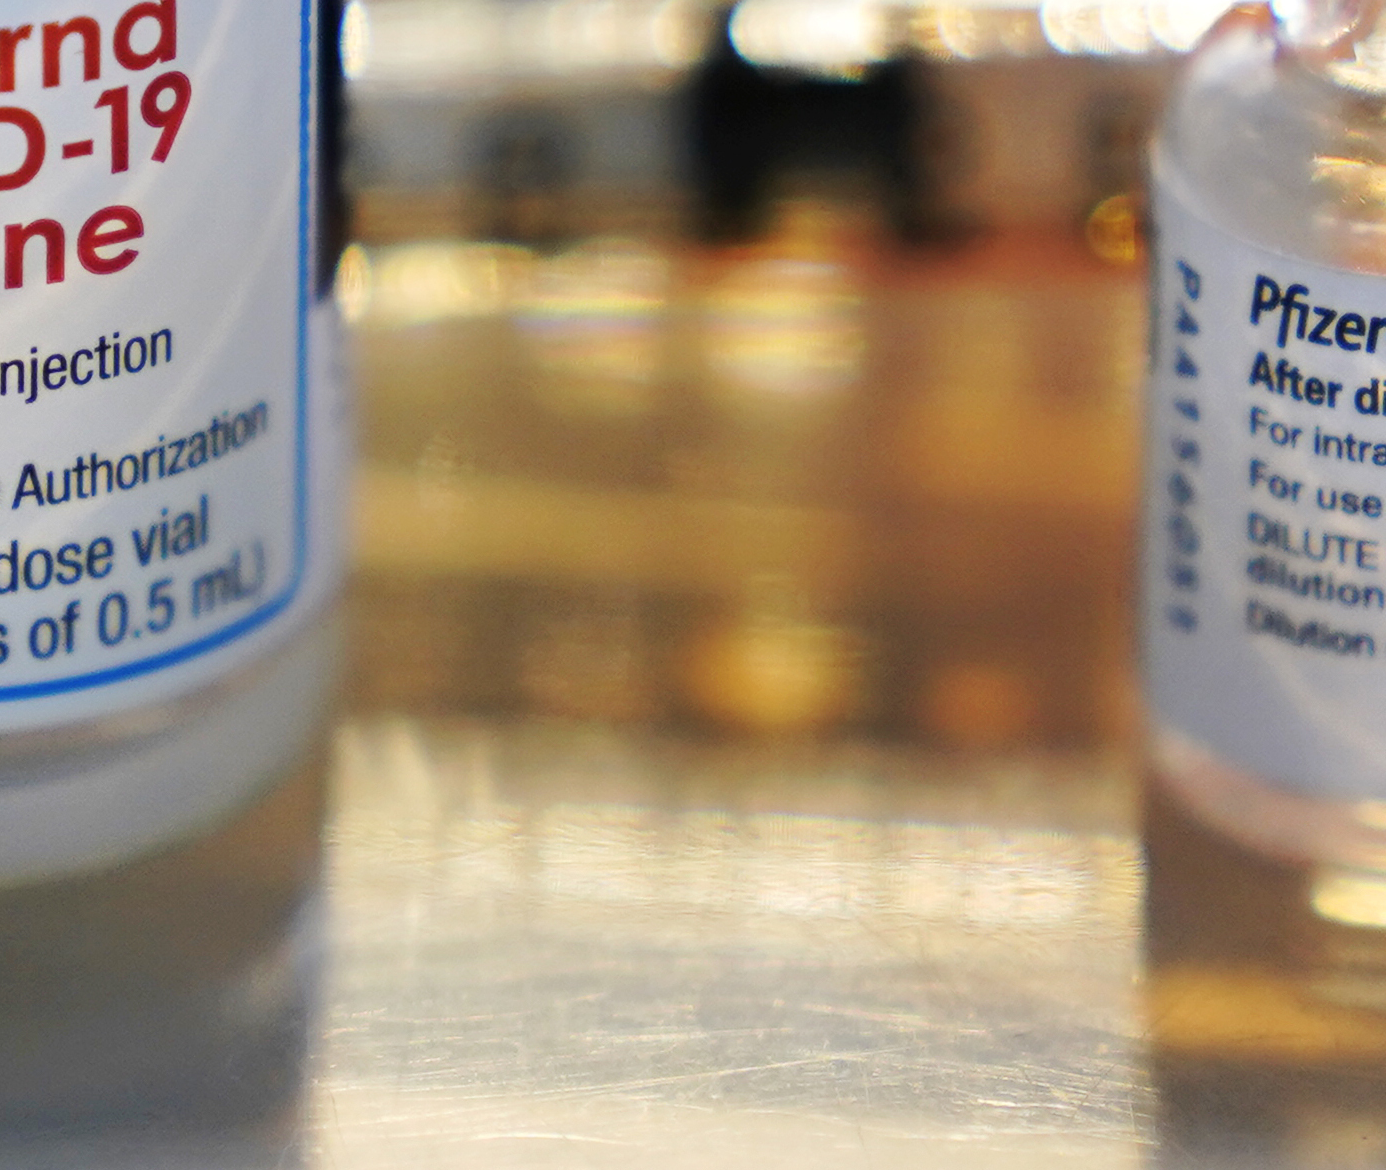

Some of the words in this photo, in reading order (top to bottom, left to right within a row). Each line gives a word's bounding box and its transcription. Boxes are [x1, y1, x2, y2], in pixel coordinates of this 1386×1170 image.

[1248, 351, 1344, 410] After
[12, 399, 269, 512] Authorization
[1248, 406, 1303, 449] For
[1248, 459, 1304, 503] For
[1316, 478, 1383, 518] use
[131, 496, 210, 567] vial
[1246, 511, 1382, 572] DILUTE
[28, 600, 81, 661] of
[97, 577, 177, 648] 0.5
